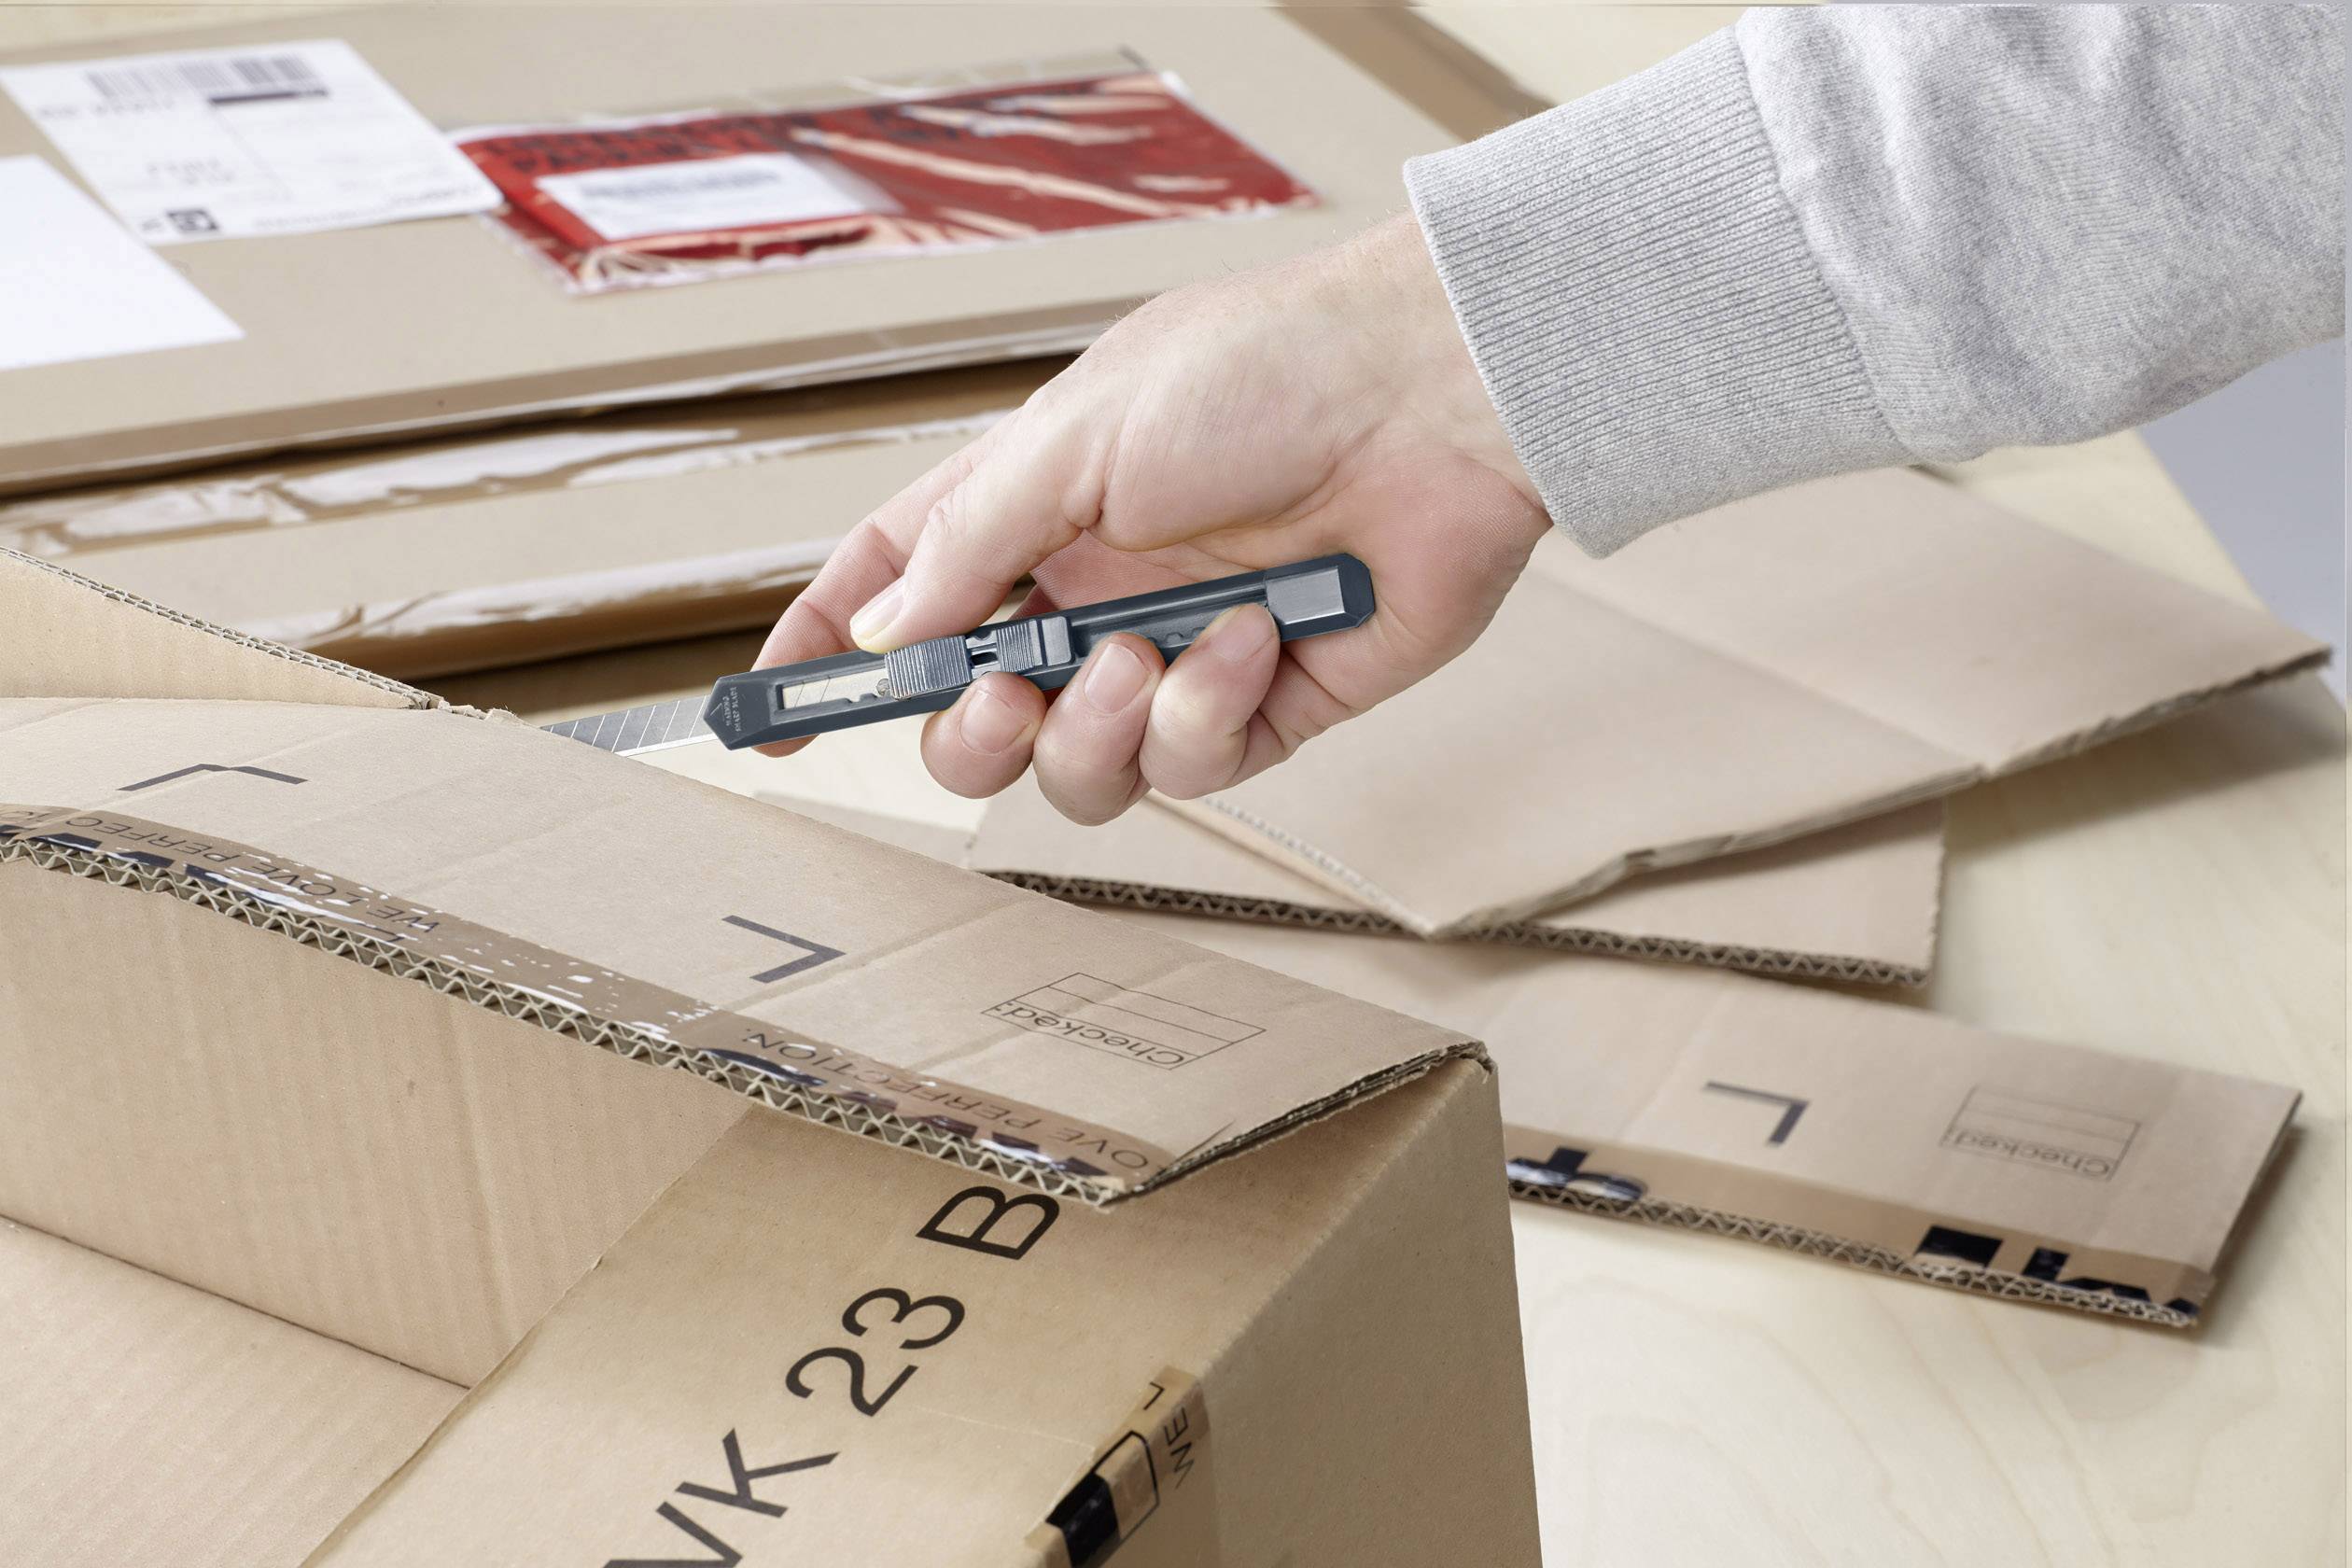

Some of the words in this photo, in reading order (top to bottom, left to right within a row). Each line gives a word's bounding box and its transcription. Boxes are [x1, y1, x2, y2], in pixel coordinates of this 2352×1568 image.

[249, 862, 371, 904] LOVE
[366, 904, 440, 933] WE
[993, 1001, 1184, 1065] Checked:
[743, 1029, 1043, 1129] PERFECTION.
[1047, 1126, 1167, 1171] OVE
[786, 1287, 966, 1417] 23
[915, 1185, 1061, 1261] B
[1163, 1407, 1195, 1491] WE
